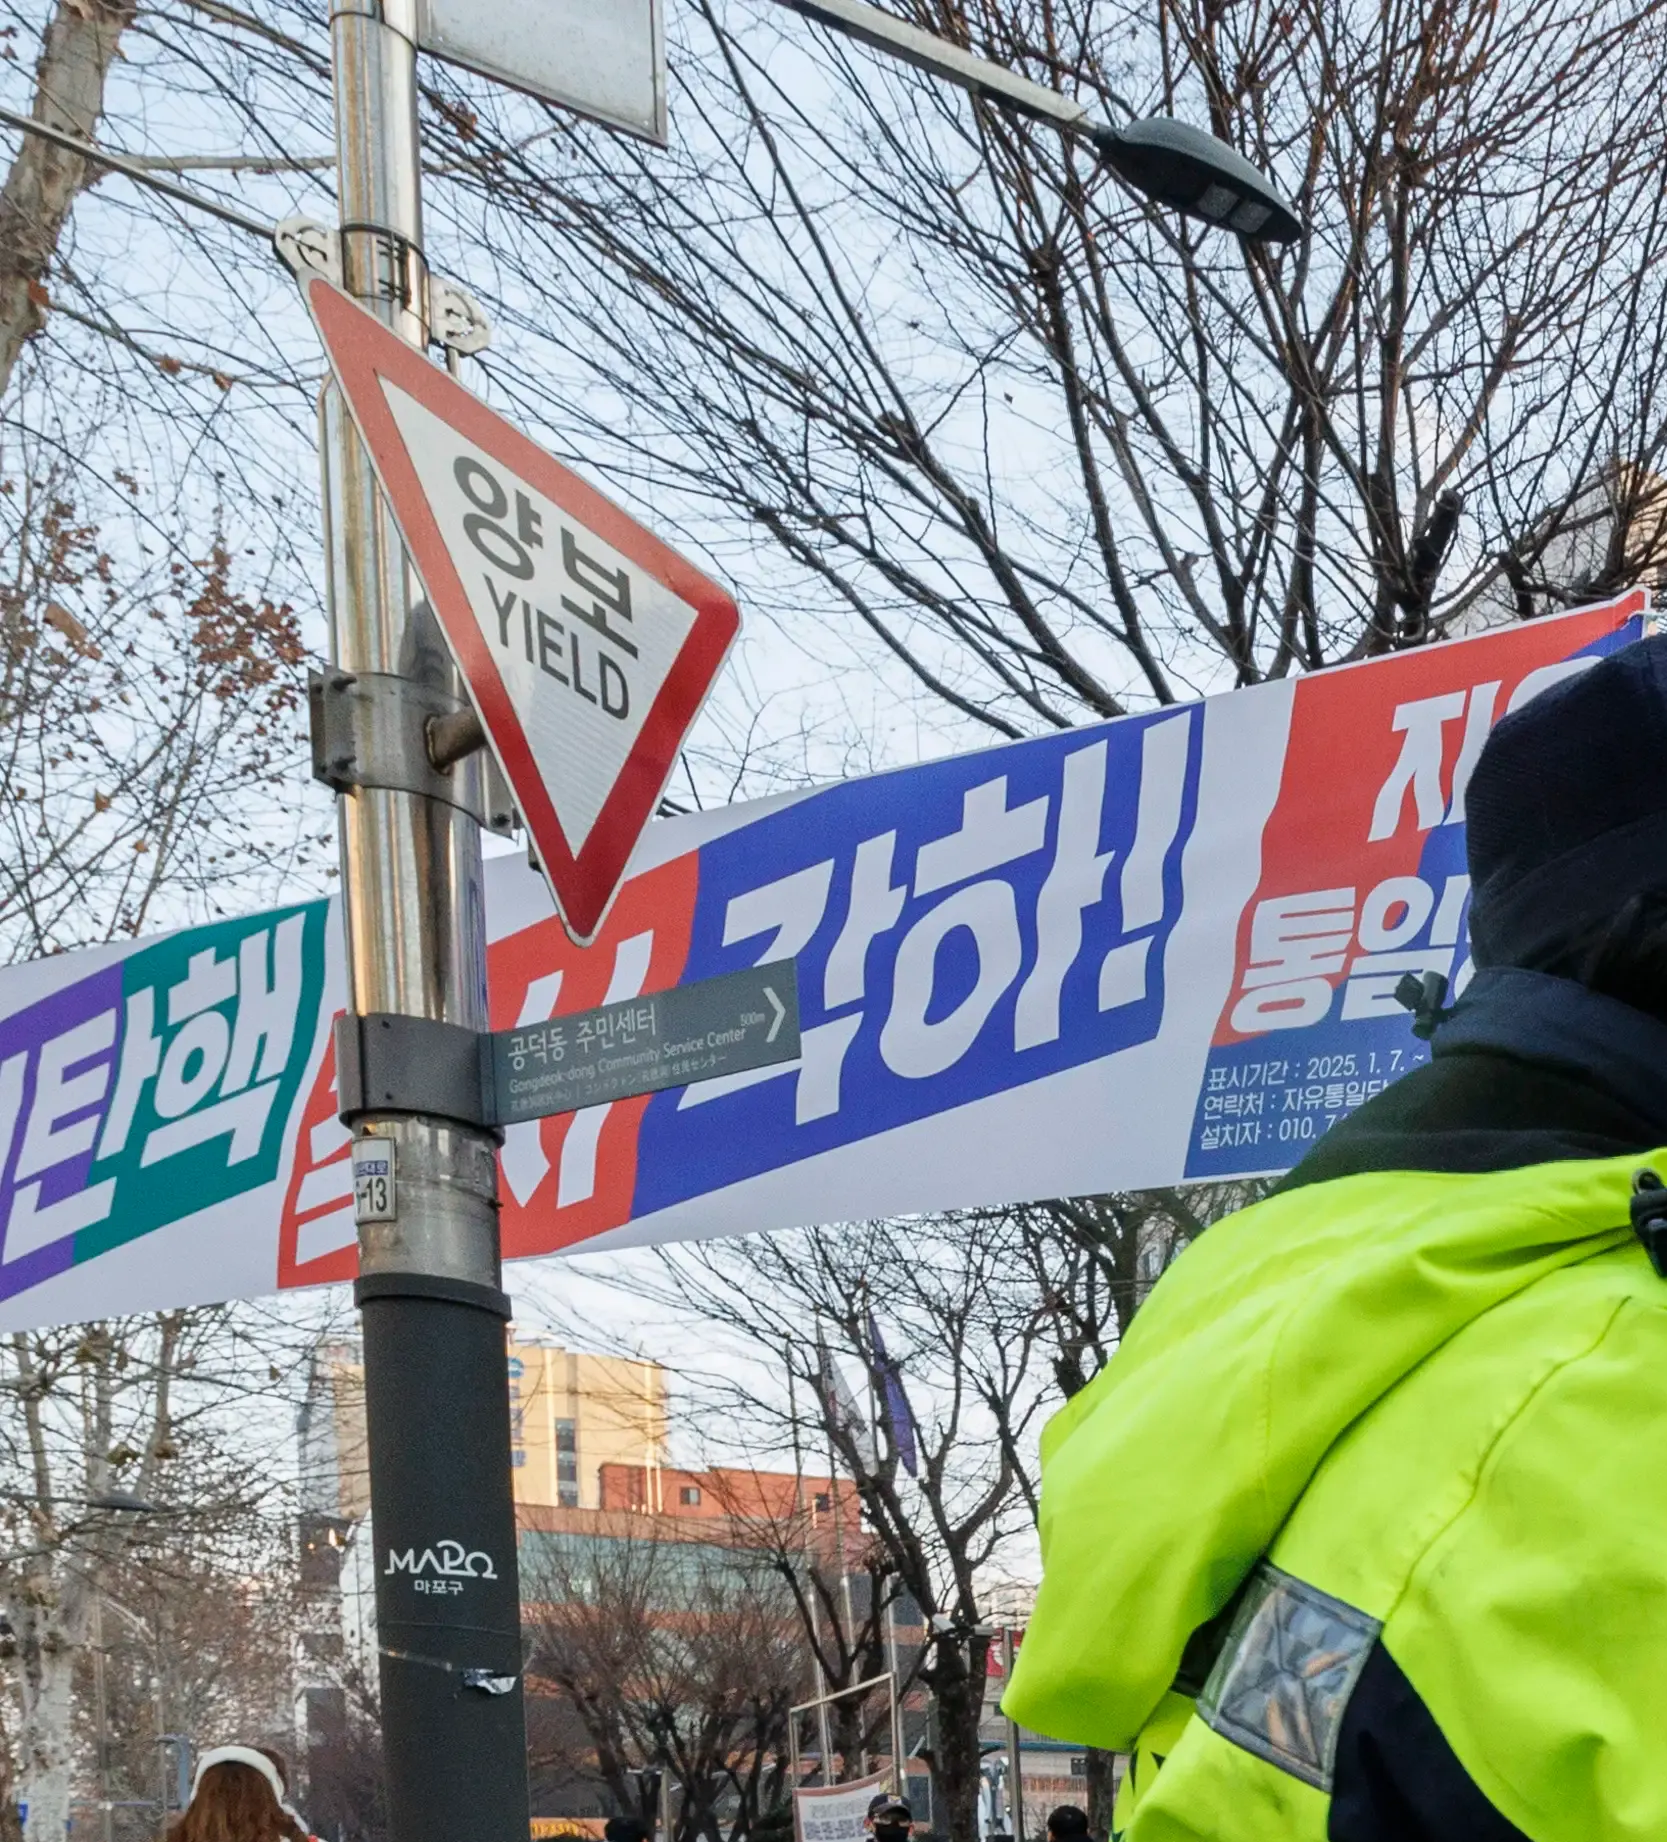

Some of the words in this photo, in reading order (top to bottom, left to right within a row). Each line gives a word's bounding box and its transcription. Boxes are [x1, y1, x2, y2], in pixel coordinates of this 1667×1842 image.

[453, 456, 639, 660] 양보
[482, 572, 630, 721] YIELD
[0, 911, 306, 1267] 탄핵
[676, 709, 1193, 1128] 각하!
[507, 1028, 569, 1071] 공덕동
[575, 1003, 658, 1055] 주민센터
[740, 1010, 766, 1027] 500m
[597, 1047, 661, 1072] Community
[663, 1037, 705, 1059] Service
[706, 1027, 747, 1048] Center
[1207, 1061, 1289, 1092] 표시기간
[1306, 1054, 1359, 1080] 2025.
[1368, 1052, 1381, 1074] 1.
[1390, 1050, 1405, 1072] 7.
[1204, 1091, 1264, 1121] 연락처
[1200, 1121, 1262, 1151] 설치자
[1278, 1115, 1317, 1141] 010.
[384, 1540, 498, 1579] MAPO
[414, 1579, 464, 1595] 마포구
